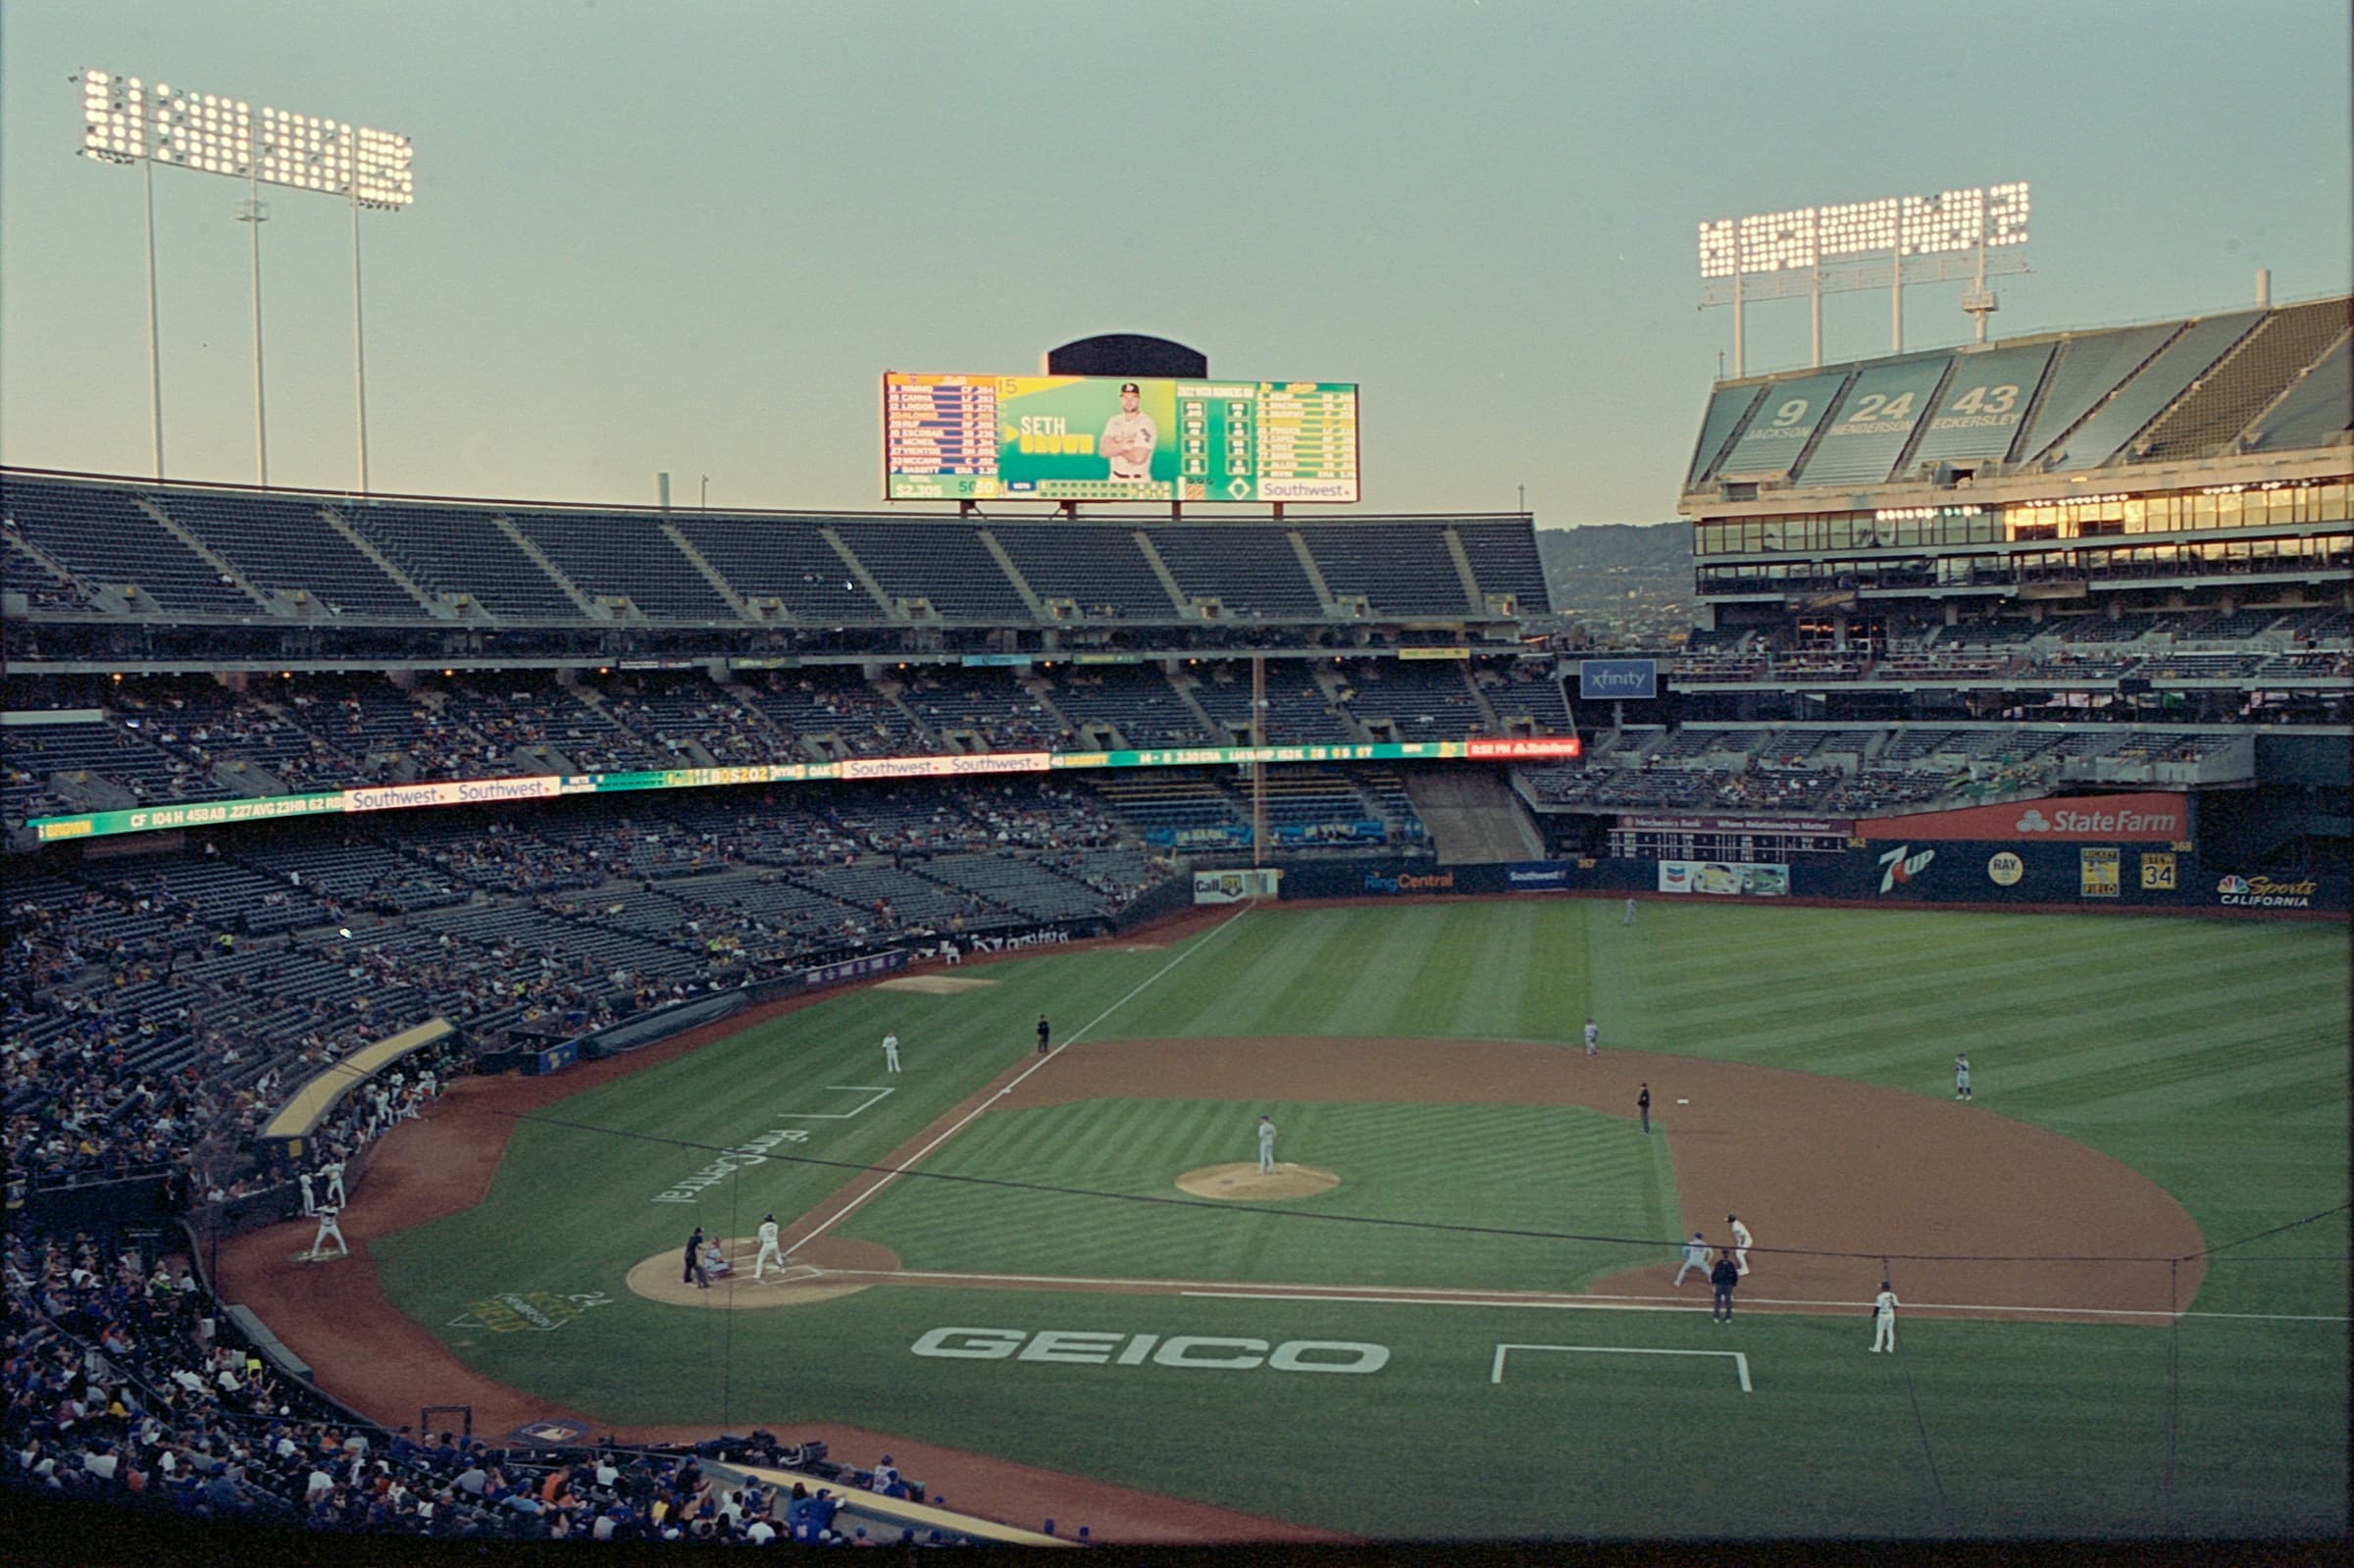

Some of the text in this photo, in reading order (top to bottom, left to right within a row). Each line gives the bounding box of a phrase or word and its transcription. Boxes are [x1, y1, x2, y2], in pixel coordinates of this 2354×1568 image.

[1848, 391, 1915, 423] 24
[1951, 385, 2020, 415] 43
[1772, 399, 1809, 427] 9
[1020, 417, 1066, 434] SETH
[1746, 426, 1812, 440] JACKSON
[1830, 420, 1915, 435] HENDERSON
[1020, 434, 1095, 454] BROWN
[1264, 483, 1342, 496] Southwest
[1591, 670, 1646, 689] xfinity
[851, 759, 932, 776] Southwest
[951, 756, 1032, 772] Southwest
[353, 787, 438, 809] Southwest
[458, 782, 542, 801] Southwest
[1680, 818, 1702, 829] Bank
[2054, 810, 2176, 833] StateFarm
[1993, 859, 2018, 871] RAY
[1510, 870, 1558, 882] Southwest
[2145, 866, 2173, 885] 34
[1196, 880, 1219, 892] Call
[2084, 885, 2116, 895] FIELD
[2248, 876, 2317, 895] Sports
[2221, 894, 2309, 907] CALIFORNIA
[911, 1327, 1390, 1373] GEICO
